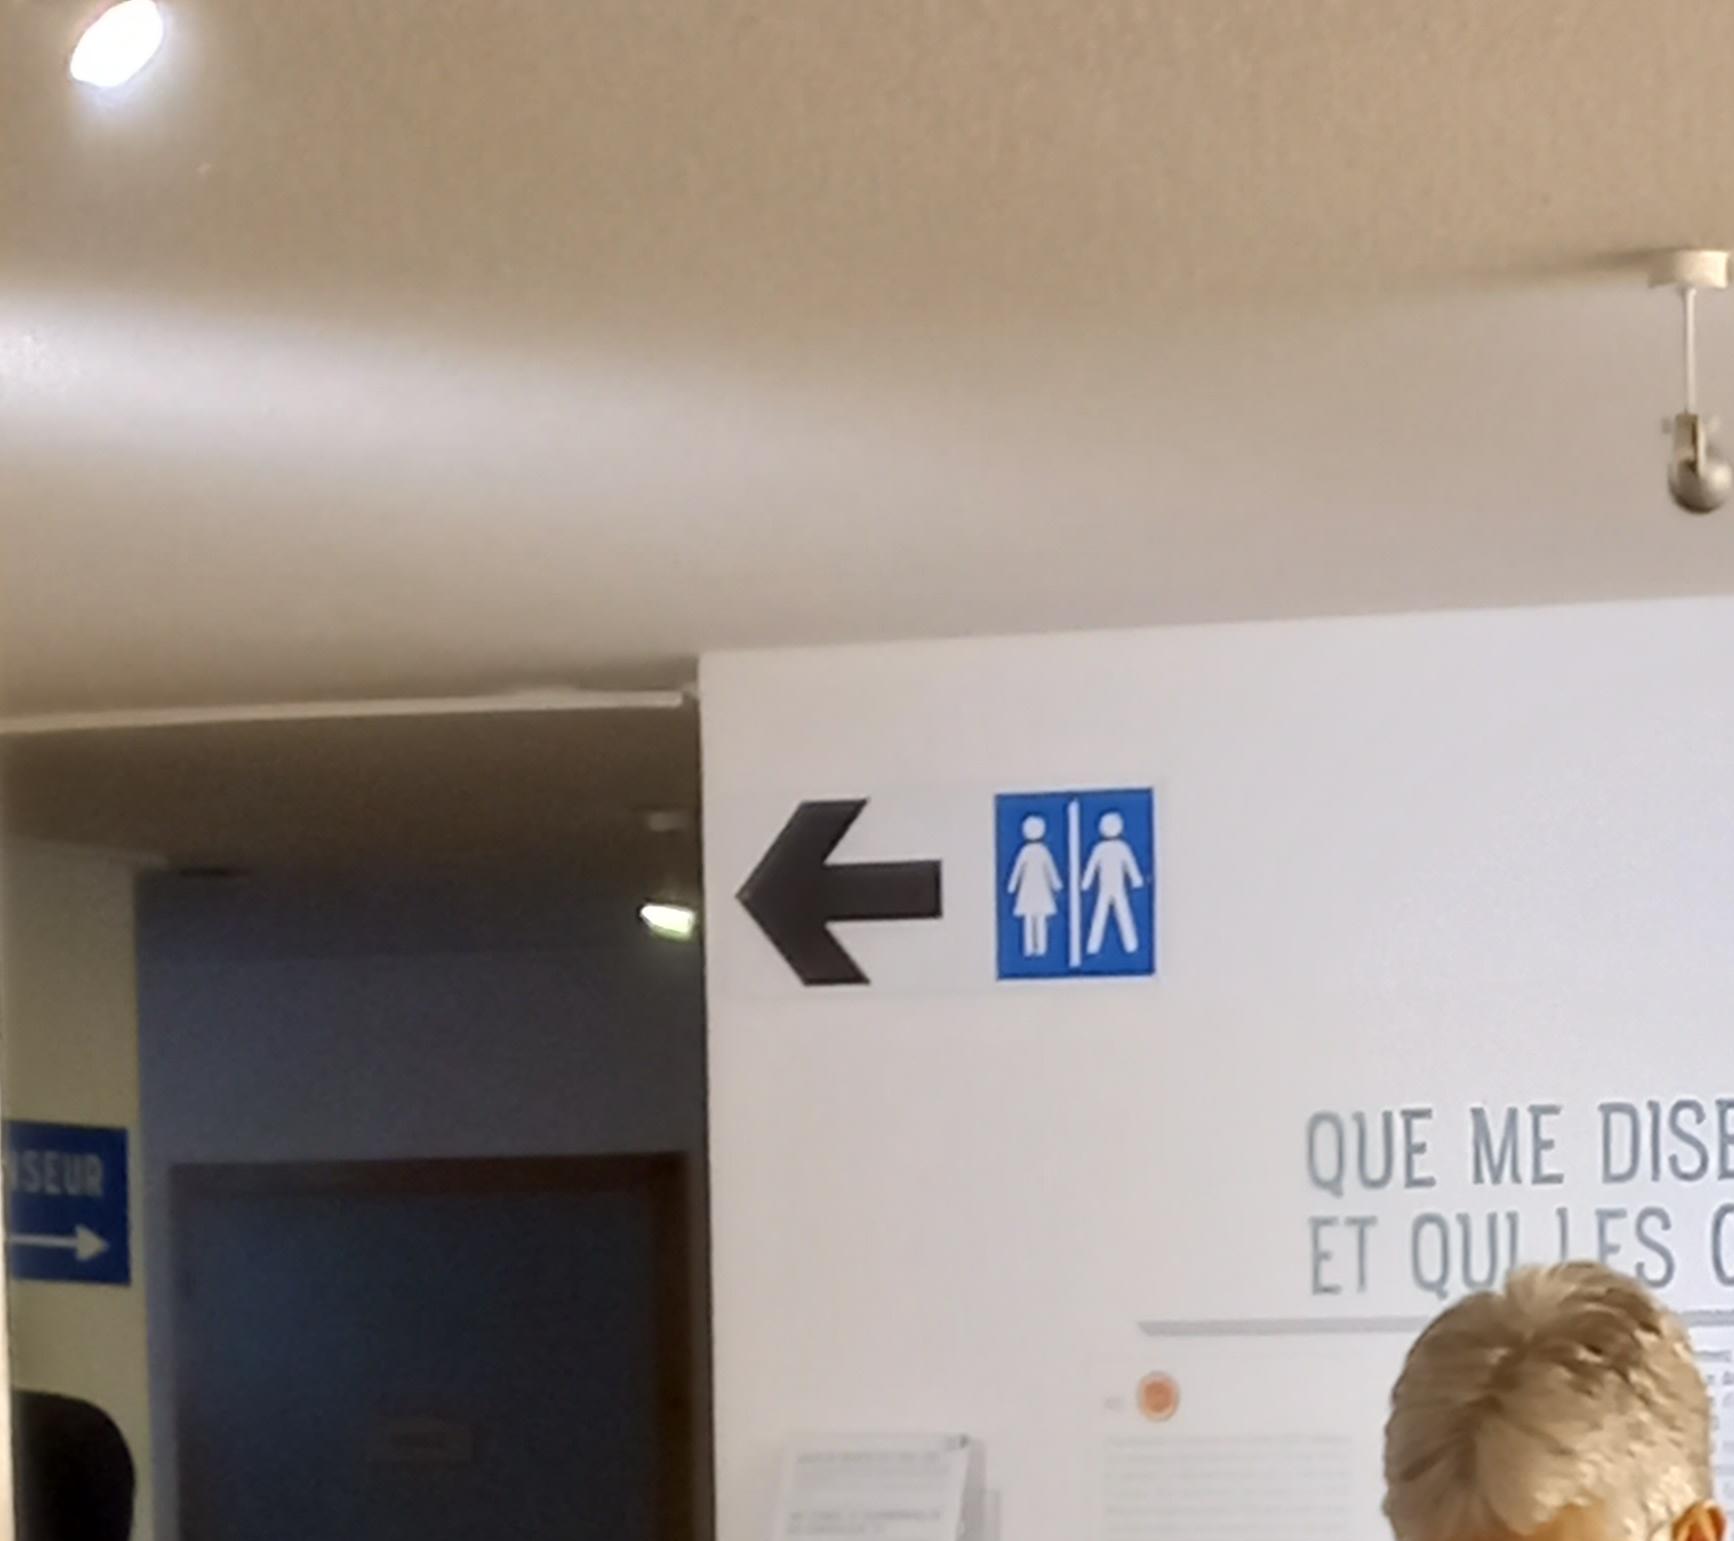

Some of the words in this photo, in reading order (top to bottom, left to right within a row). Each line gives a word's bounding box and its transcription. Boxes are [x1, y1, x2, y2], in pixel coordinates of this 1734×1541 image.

[1307, 1108, 1436, 1199] QUE
[1470, 1104, 1565, 1185] ME
[1309, 1215, 1376, 1295] ET
[1410, 1210, 1519, 1300] QUI
